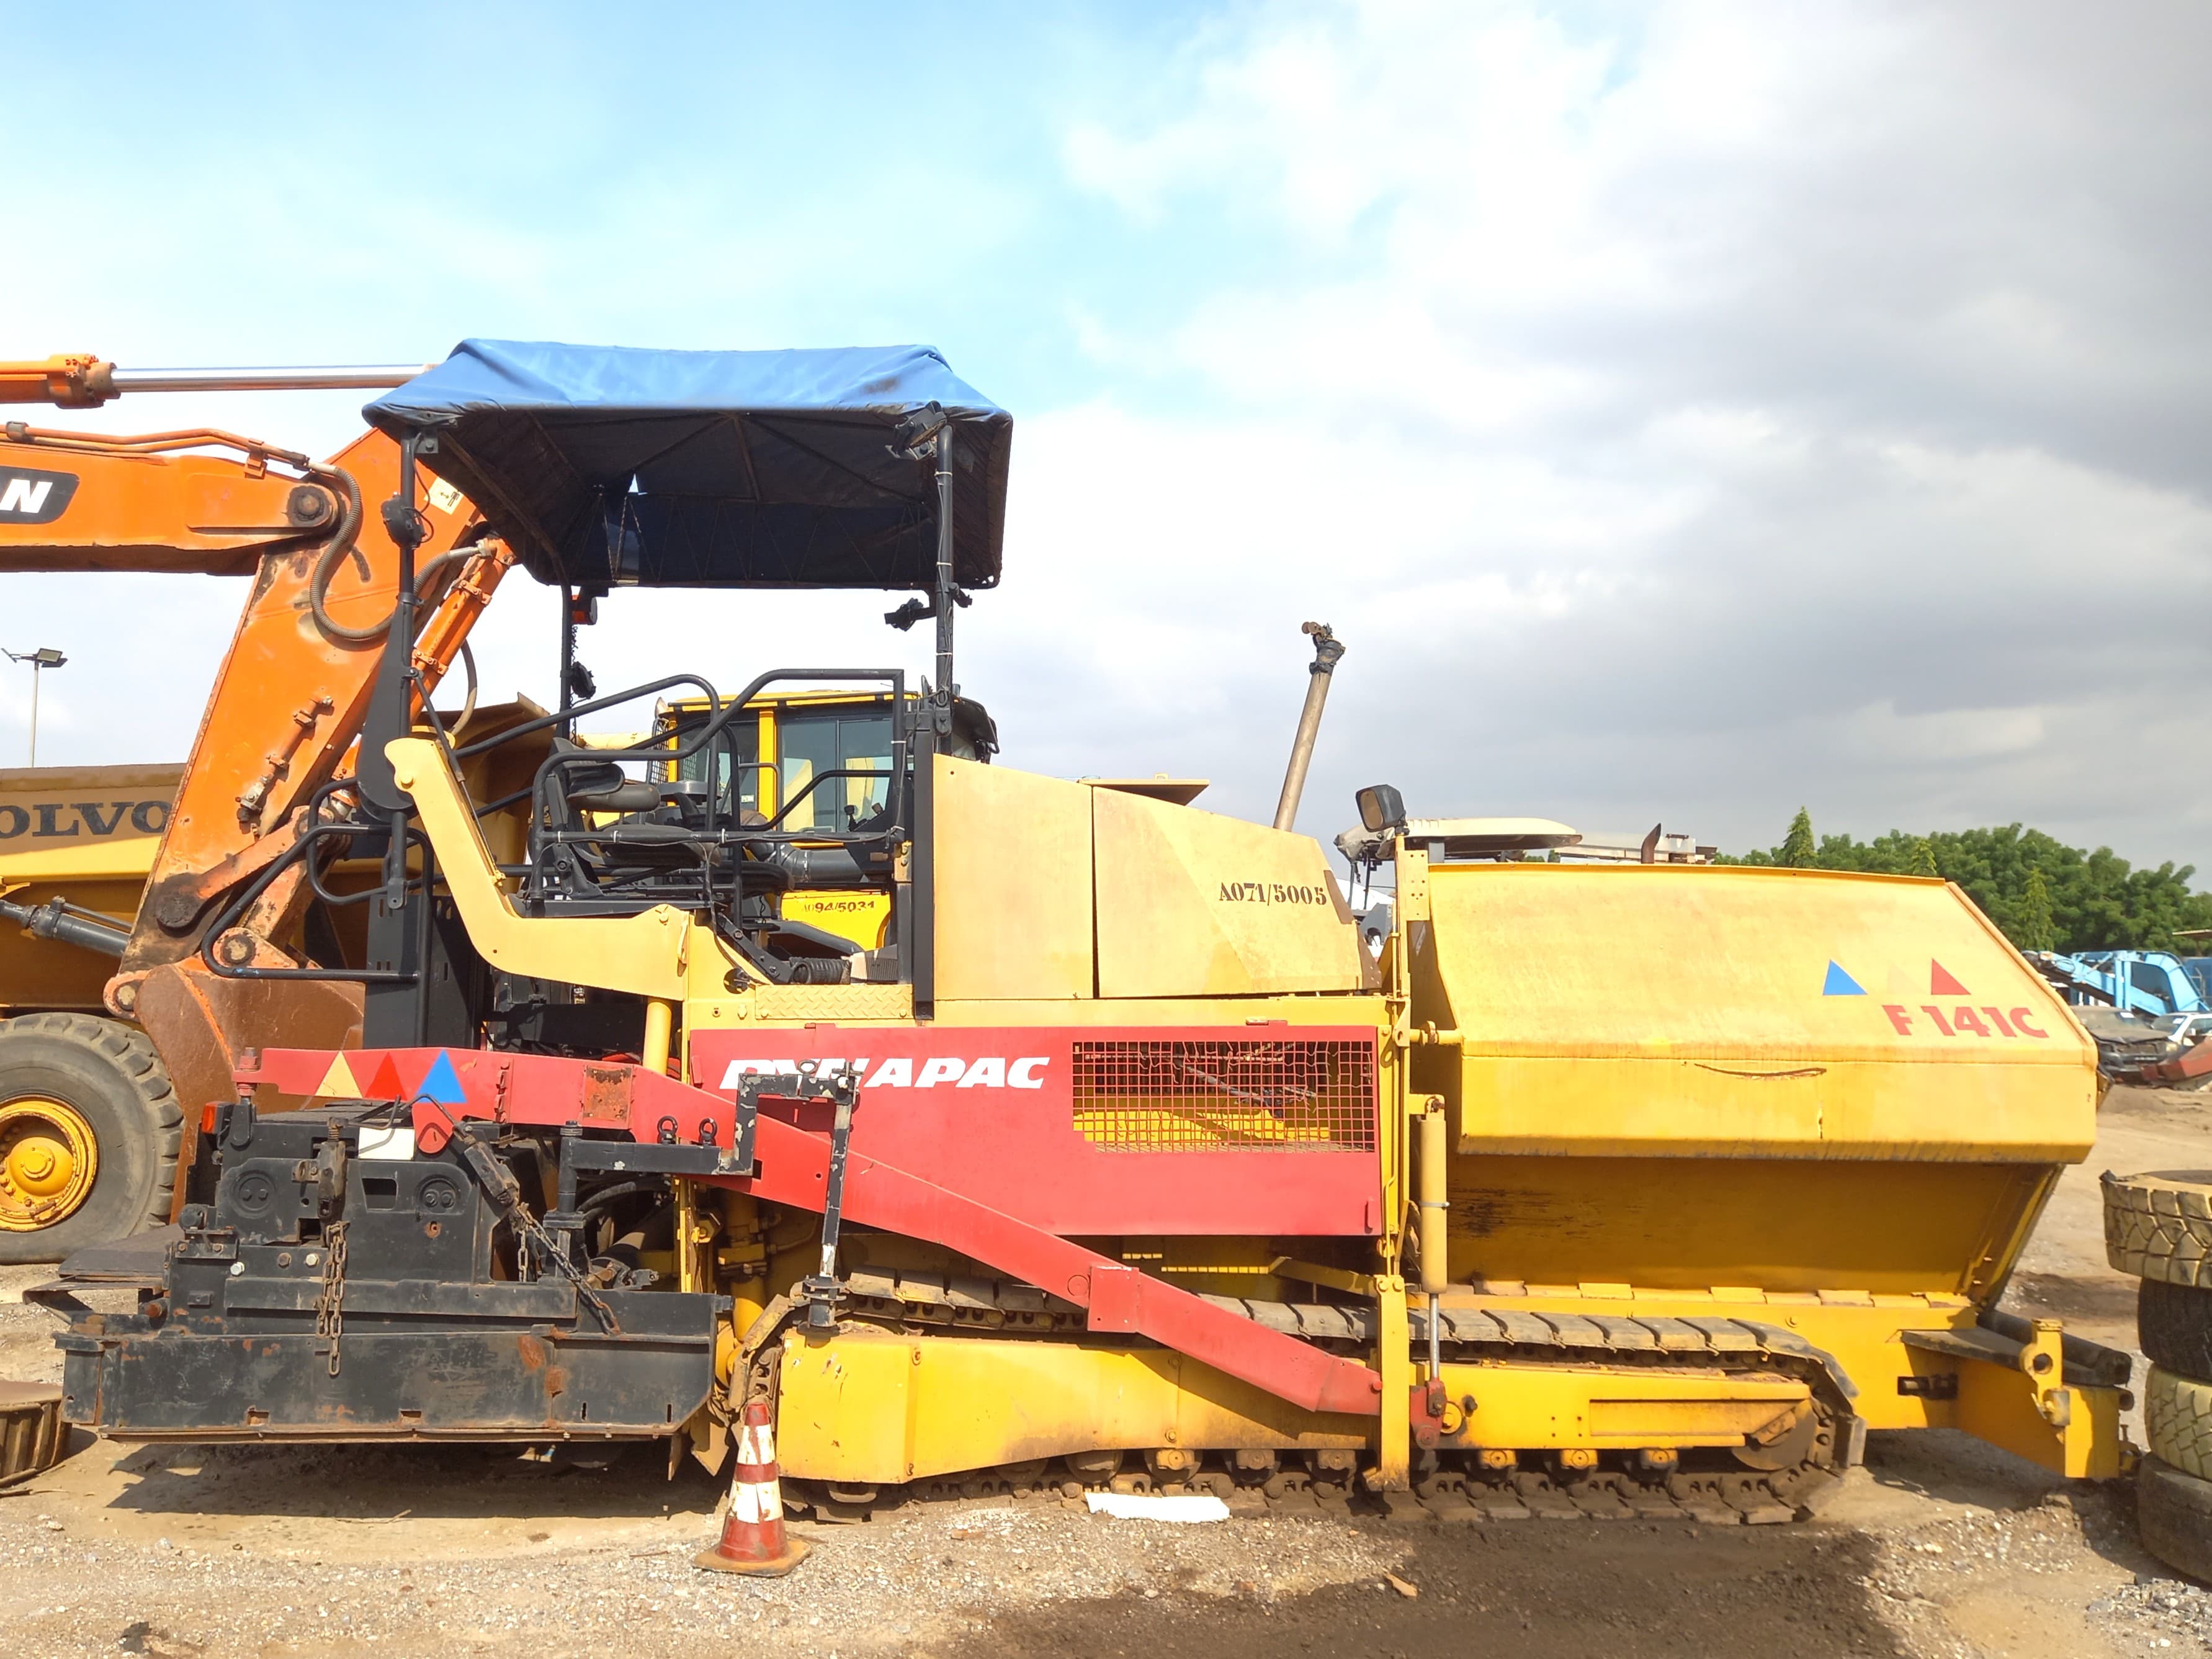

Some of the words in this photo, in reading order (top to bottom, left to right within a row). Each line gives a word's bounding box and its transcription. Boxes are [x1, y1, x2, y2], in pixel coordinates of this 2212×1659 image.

[1219, 882, 1327, 906] A071/5005
[1882, 1005, 1912, 1035] F
[1920, 1005, 2049, 1038] 141C
